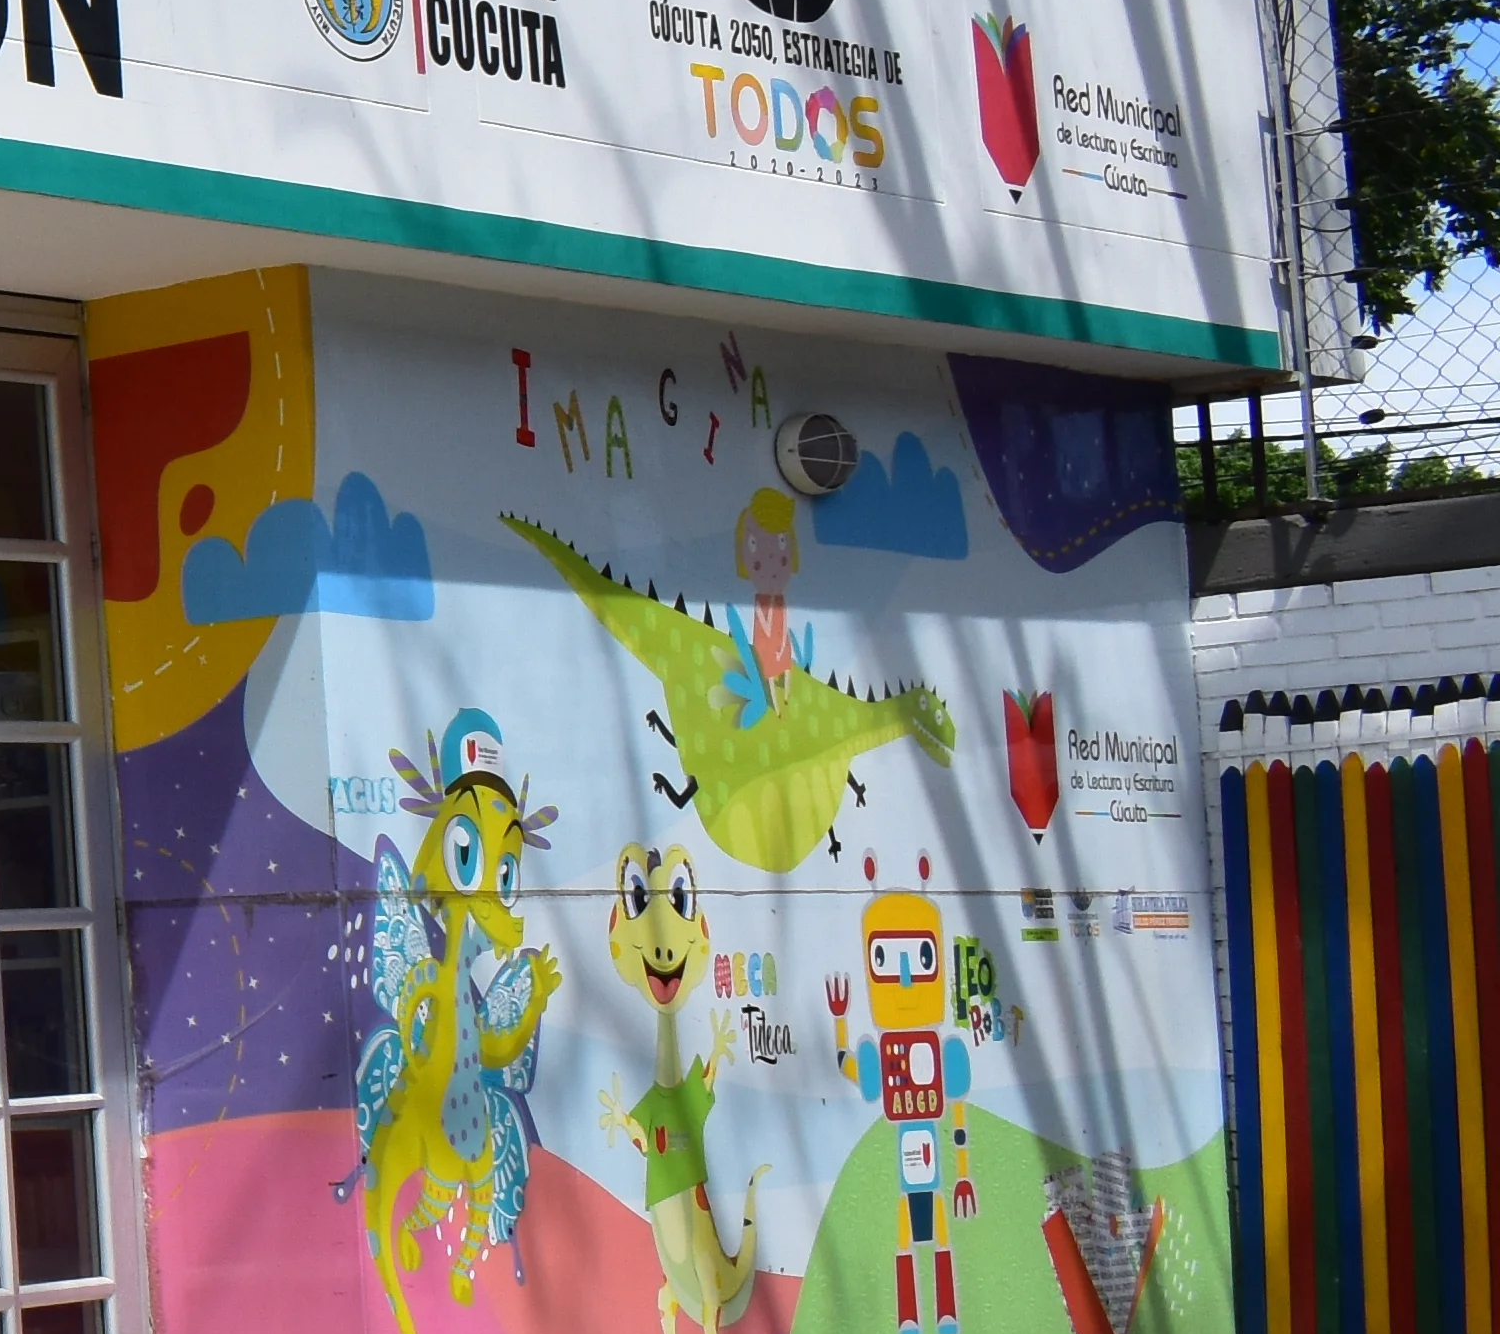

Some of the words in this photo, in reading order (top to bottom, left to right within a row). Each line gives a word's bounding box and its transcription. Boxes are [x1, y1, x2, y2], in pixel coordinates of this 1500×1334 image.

[730, 19, 778, 64] 2050,
[782, 28, 880, 82] ESTRATEGIA
[883, 49, 904, 86] DE
[689, 62, 885, 169] TODOS
[1052, 73, 1092, 117] Red
[1095, 83, 1182, 143] Municipal
[1056, 121, 1073, 146] de
[1075, 124, 1118, 156] Lectura
[1120, 140, 1129, 163] y
[1130, 137, 1179, 169] Escritura
[1103, 163, 1149, 198] Cúcuta
[1067, 728, 1101, 762] Red
[1104, 730, 1178, 772] Municipal
[1070, 769, 1085, 790] de
[1086, 770, 1122, 792] Lectura
[1123, 777, 1132, 795] y
[1132, 772, 1175, 794] Escritura
[1108, 799, 1149, 824] Cúcuta
[953, 943, 993, 1021] LEO
